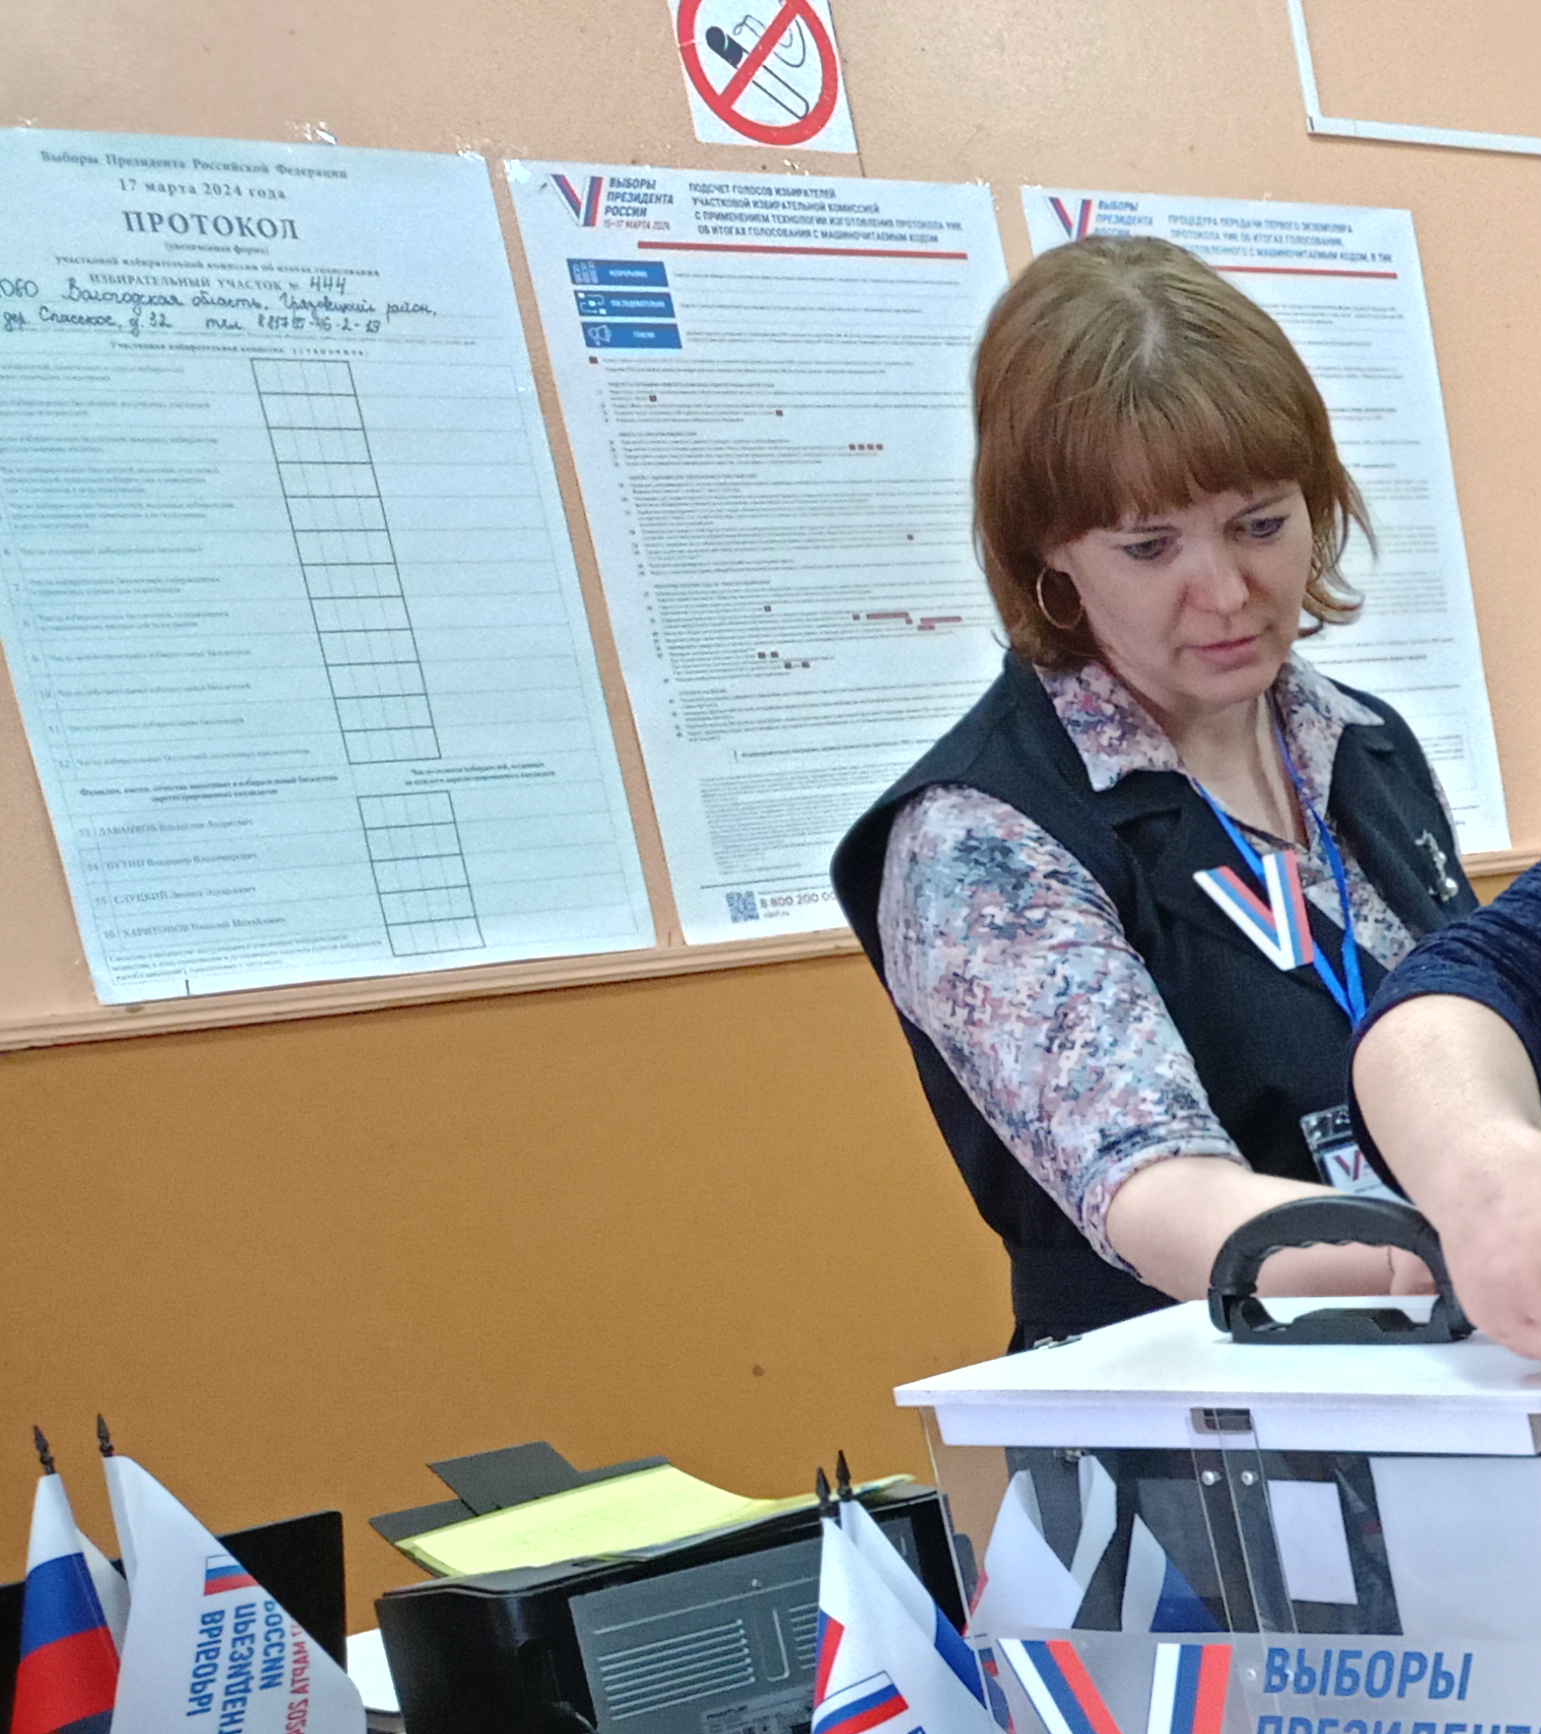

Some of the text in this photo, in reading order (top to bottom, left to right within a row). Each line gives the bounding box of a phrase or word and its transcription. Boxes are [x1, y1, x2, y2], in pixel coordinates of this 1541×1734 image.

[41, 151, 347, 180] Выборы Президента Российской Федерации
[120, 178, 286, 200] 17 марта 2024 года
[609, 177, 656, 190] ВЫБОРЫ
[689, 182, 836, 198] ПОДСЧЕТ ГОЛОСОВ ИЗБИРАТЕЛЕЙ
[607, 191, 673, 204] ПРЕЗИДЕНТА
[692, 197, 880, 214] УЧАСТКОВОЙ ИЗБИРАТЕЛЬНОЙ КОМИССИЕЙ
[605, 205, 647, 217] РОССИИ
[1098, 200, 1139, 212] ВЫБОРЫ
[122, 211, 299, 240] ПРОТОКОЛ
[712, 226, 746, 236] ИТОГАХ
[90, 273, 211, 289] ИЗБИРАТЕЛЬНЫЙ
[218, 278, 281, 291] УЧАСТОК
[310, 276, 347, 295] 444
[1263, 1647, 1473, 1701] ВЫБОРЫ
